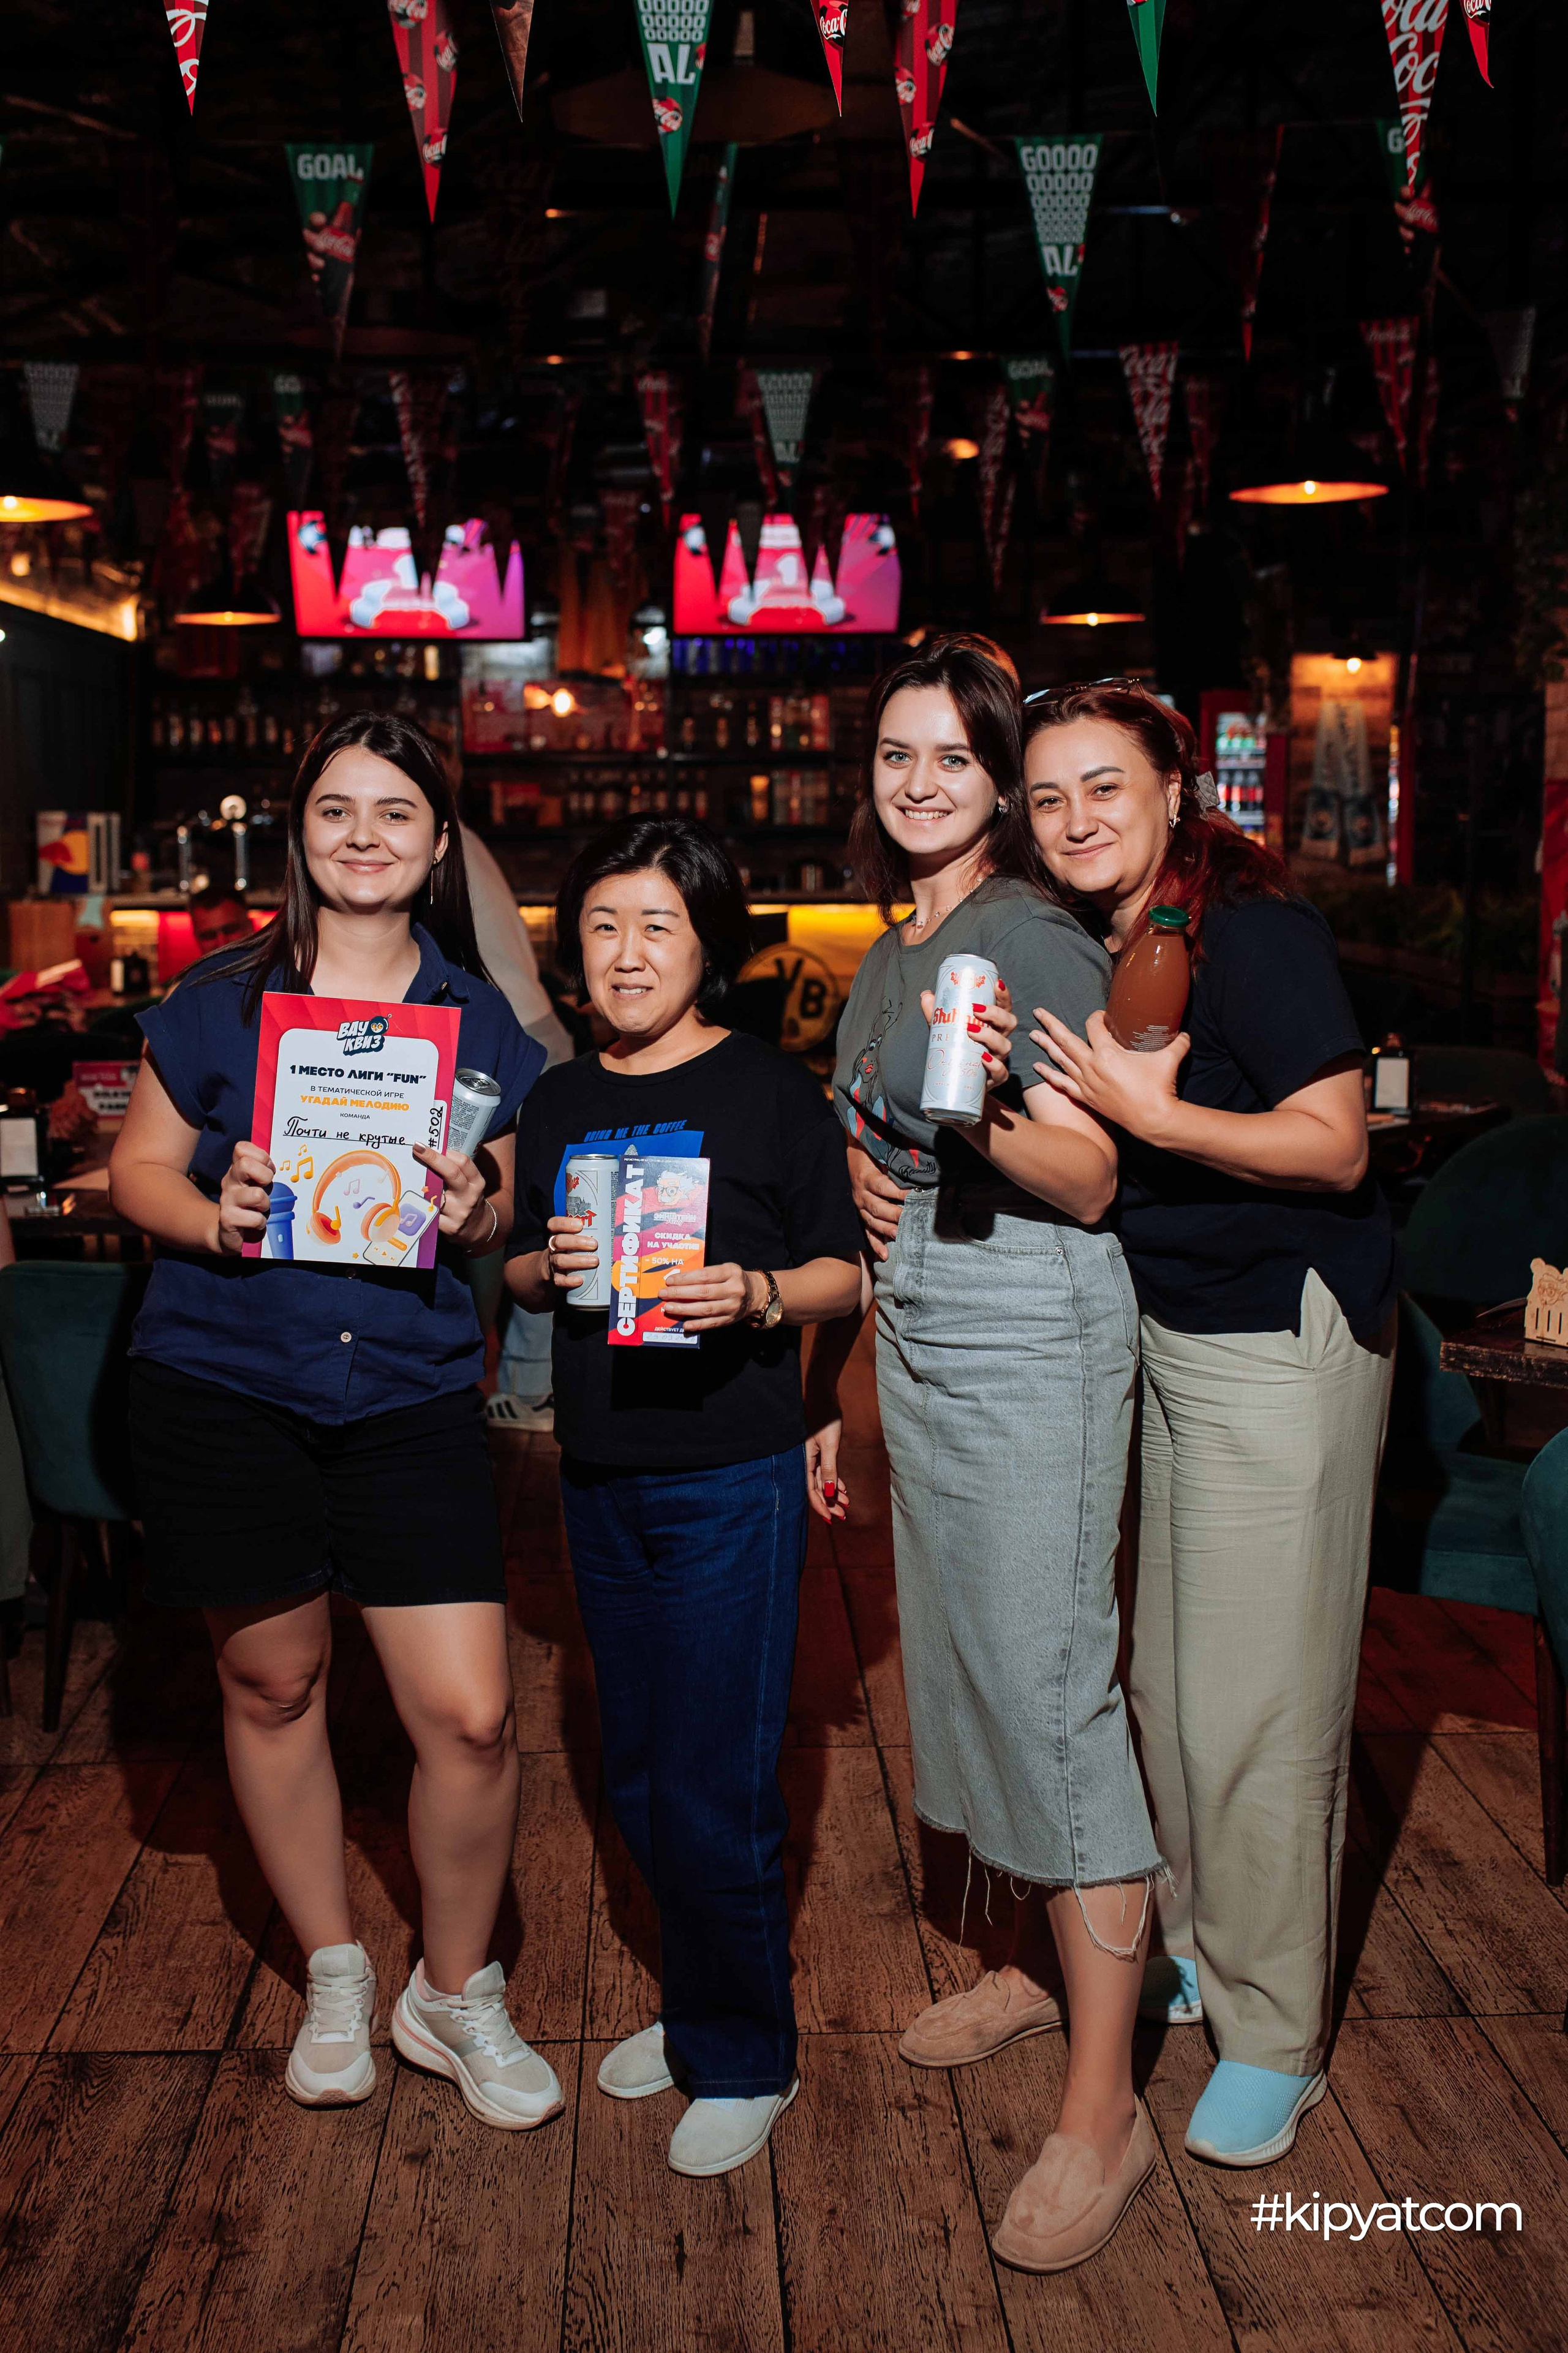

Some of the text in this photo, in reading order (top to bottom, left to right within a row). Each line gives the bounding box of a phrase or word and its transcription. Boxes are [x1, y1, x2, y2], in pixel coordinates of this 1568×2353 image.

[647, 42, 696, 84] AL
[297, 153, 364, 180] GOAL
[1020, 144, 1098, 172] GOOOO
[1042, 245, 1079, 277] AL
[337, 1021, 370, 1039] ВАУ
[344, 1035, 382, 1052] КВИЗ
[290, 1065, 296, 1075] 1
[298, 1065, 344, 1078] МЕСТО
[347, 1069, 383, 1081] ЛИГИ
[300, 1095, 410, 1111] УГАДАЙ МЕЛОДИЮ
[318, 1086, 382, 1097] ТЕМАТИЧЕСКОЙ
[284, 1116, 405, 1149] Почти не крутые
[428, 1106, 443, 1148] #502
[614, 1127, 629, 1139] ME
[631, 1124, 650, 1136] THE
[653, 1119, 688, 1135] COFFEE
[616, 1164, 644, 1337] СЕРТИФИКАТ
